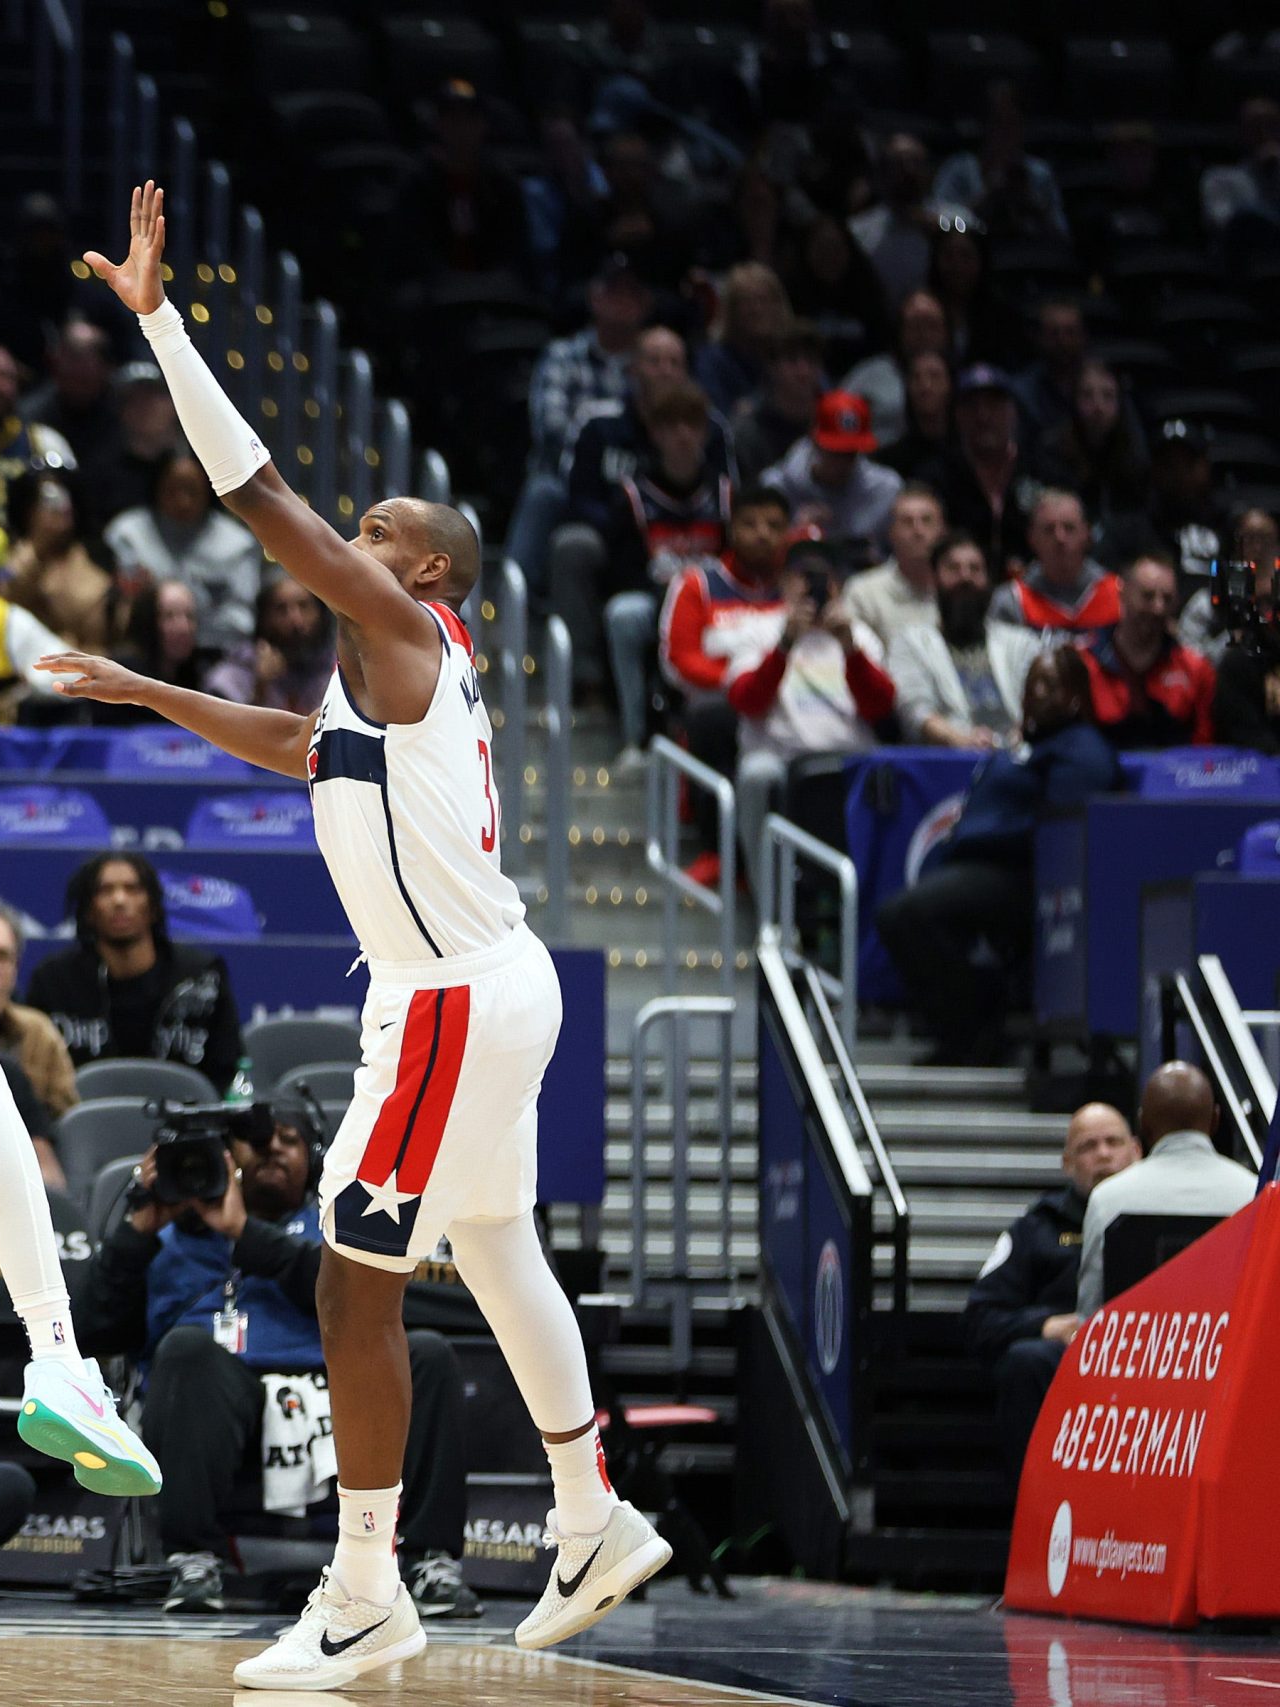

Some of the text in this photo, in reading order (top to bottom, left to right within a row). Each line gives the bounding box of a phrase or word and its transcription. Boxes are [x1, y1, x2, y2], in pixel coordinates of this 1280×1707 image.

[477, 738, 502, 853] 3
[1079, 1308, 1229, 1381] GREENBERG
[1051, 1403, 1207, 1478] &BEDERMAN
